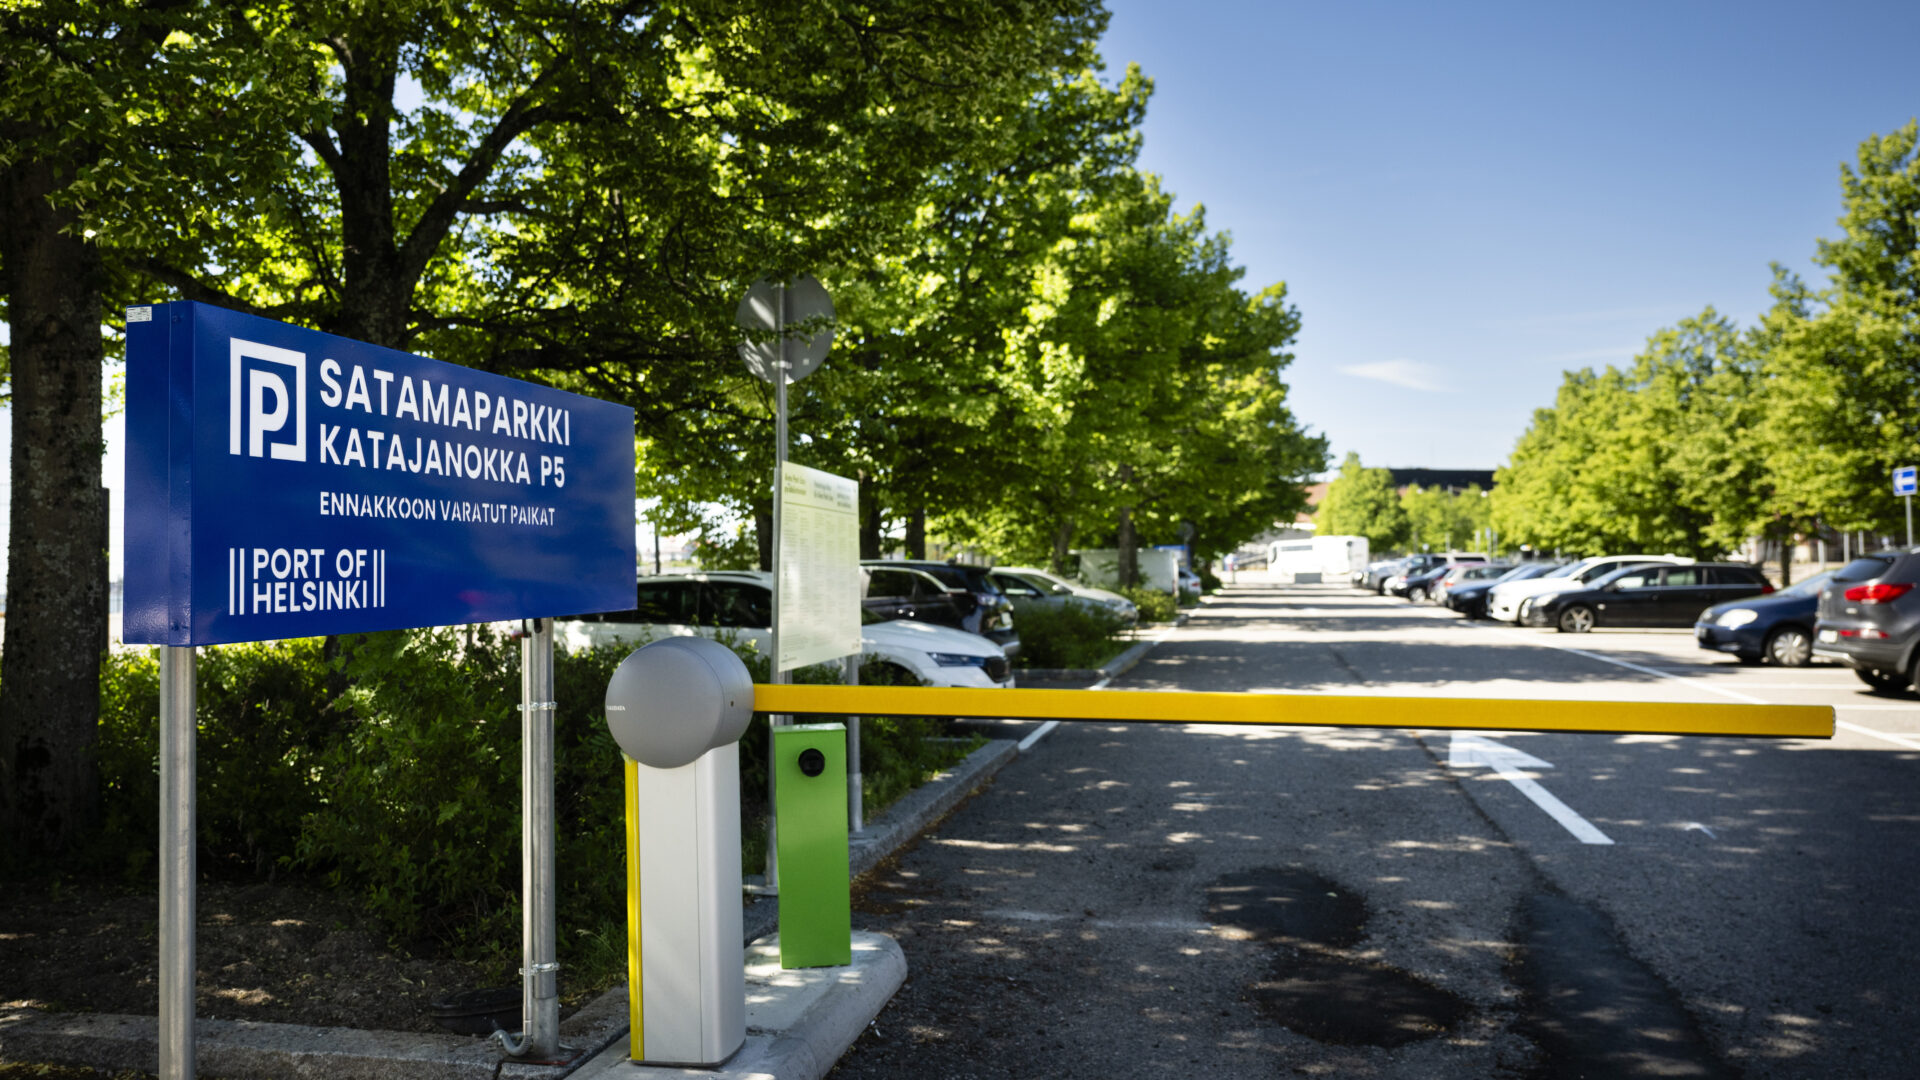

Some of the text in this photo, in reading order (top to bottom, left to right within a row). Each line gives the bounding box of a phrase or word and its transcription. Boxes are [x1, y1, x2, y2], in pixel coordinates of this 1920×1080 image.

[319, 358, 570, 446] SATAMAPARKKI
[319, 423, 565, 488] KATAJANOKKA P5
[320, 491, 555, 526] ENNAKKOON VARATUT PAIKAT
[253, 548, 368, 580] PORT OF
[253, 580, 368, 614] HELSINKI
